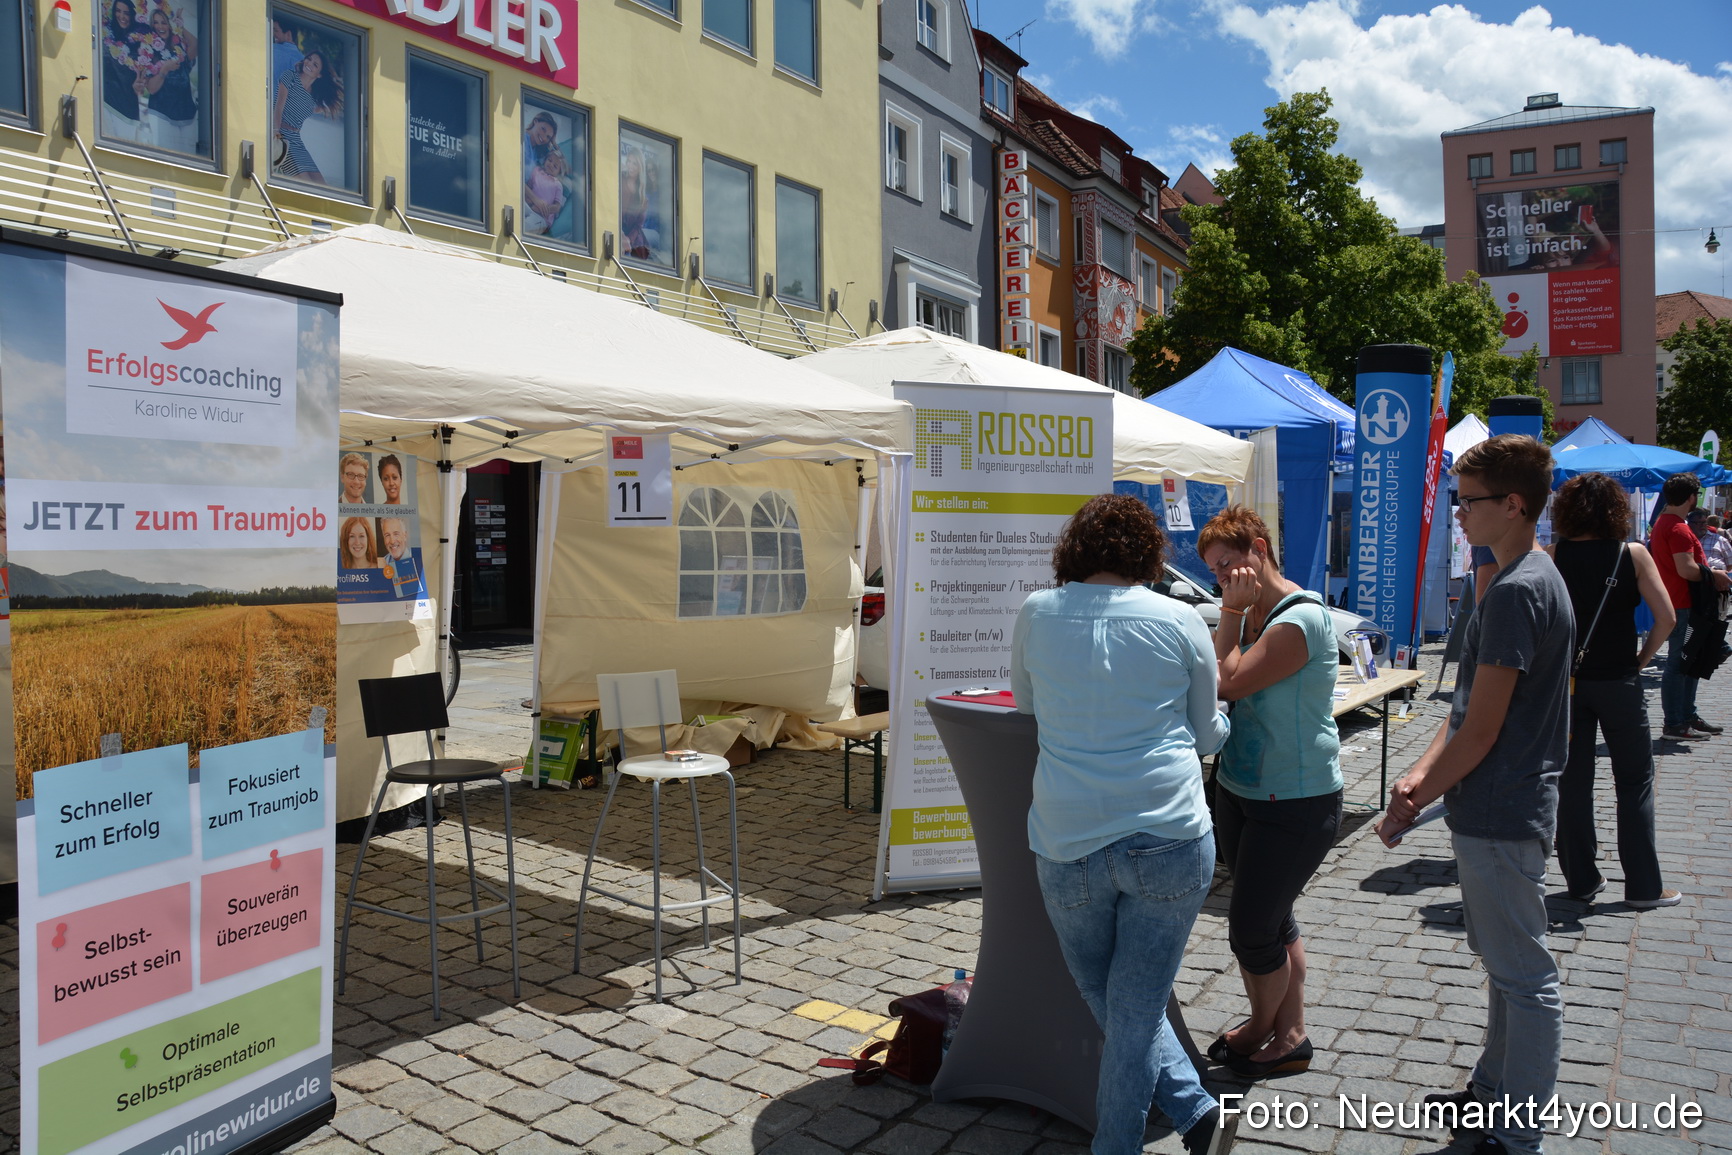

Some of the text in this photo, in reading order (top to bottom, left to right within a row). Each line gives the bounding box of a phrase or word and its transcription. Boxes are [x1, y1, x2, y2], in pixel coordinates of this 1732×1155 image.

[385, 0, 566, 72] LER
[410, 114, 446, 132] ntdecke die
[410, 124, 462, 152] EUE SEITE
[1486, 198, 1572, 220] Schneller
[1486, 220, 1546, 239] zahlen
[1004, 152, 1022, 342] BÄCKEREI
[1486, 236, 1588, 258] ist einfach.
[1552, 306, 1602, 315] SparkassenCard
[1566, 313, 1614, 322] Kassenterminal
[87, 348, 282, 398] Erfolgscoaching
[135, 400, 244, 424] Karoline Widur
[978, 411, 1094, 458] ROSSBO
[977, 458, 1094, 475] Ingenieurgesellschaft mbH
[618, 482, 641, 512] 11
[915, 495, 989, 510] Wir stellen ein:
[23, 501, 327, 538] JETZT zum Traumjob
[377, 506, 385, 514] als
[386, 506, 394, 514] Sie
[1168, 504, 1182, 522] 10
[931, 530, 978, 543] Studenten
[980, 530, 994, 543] für
[996, 531, 1026, 544] Duales
[1356, 450, 1381, 622] ÜRNBERGER
[942, 546, 954, 554] der
[954, 546, 986, 556] Ausbildung
[1002, 547, 1050, 556] Diplomingenieur
[930, 558, 940, 566] für
[940, 558, 950, 566] die
[950, 558, 986, 568] Fachrichtung
[988, 558, 1026, 568] Versorgungs-
[1028, 558, 1038, 566] und
[930, 580, 1006, 594] Projektingenieur
[1018, 580, 1058, 592] Technike
[930, 596, 990, 606] für die Schwerpunkte
[958, 607, 968, 616] und
[1005, 607, 1020, 615] Vers
[930, 629, 1004, 642] Bauleiter (m/w)
[950, 644, 989, 654] Schwerpunkte
[930, 666, 1012, 680] Teamassistenz (in
[914, 733, 936, 742] Unsere
[914, 757, 936, 766] Unsere
[228, 764, 301, 796] Fokusiert
[60, 790, 153, 825] Schneller
[208, 788, 320, 830] zum Traumjob
[54, 818, 160, 859] zum Erfolg
[912, 824, 974, 840] bewerbung@
[934, 846, 978, 856] Ingenieurgesellsc
[228, 884, 300, 916] Souverän
[216, 908, 308, 948] überzeugen
[84, 928, 152, 960] Selbst-
[54, 948, 182, 1003] bewusst sein
[162, 1020, 240, 1063] Optimale
[116, 1034, 276, 1113] Selbstpräsentation
